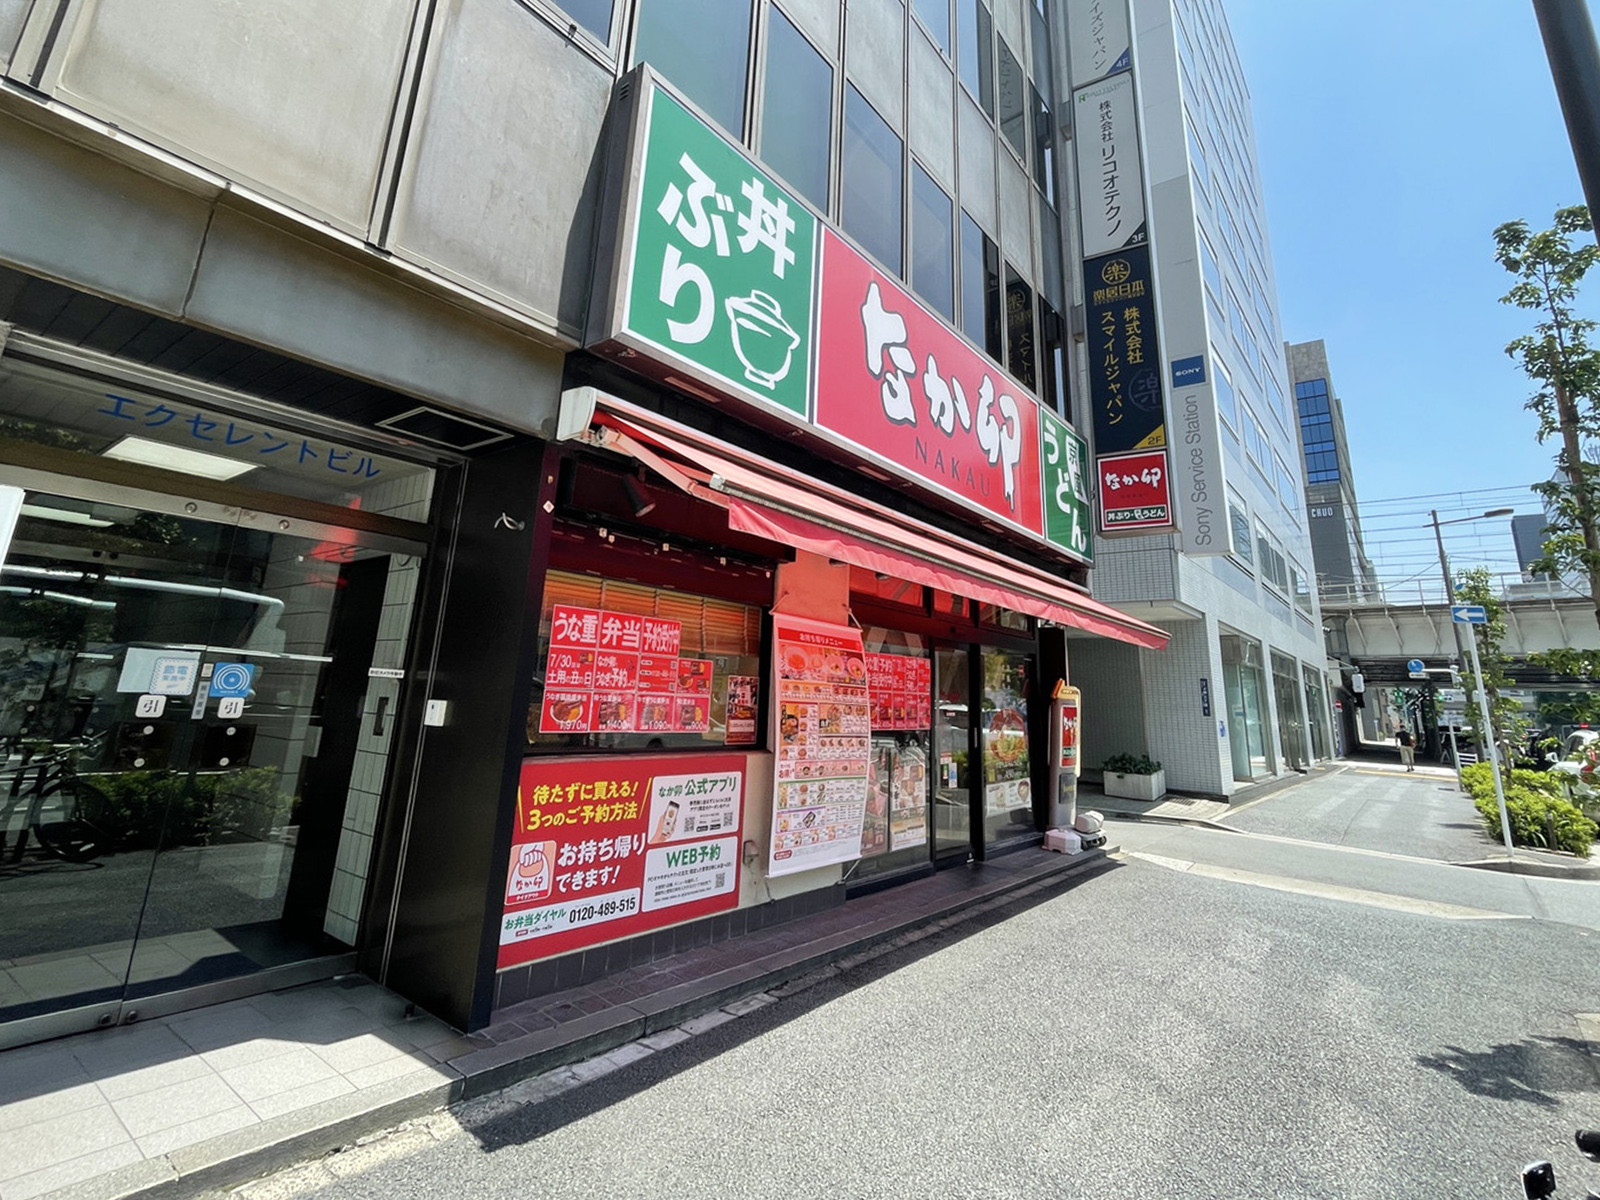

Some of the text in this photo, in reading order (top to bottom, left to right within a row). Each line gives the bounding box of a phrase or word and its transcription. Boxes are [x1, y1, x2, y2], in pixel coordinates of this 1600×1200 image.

[1116, 57, 1129, 67] 4F
[1132, 232, 1145, 243] 3F
[1124, 306, 1143, 364] 株式会社
[1101, 311, 1123, 425] スマイルジャパン
[1175, 367, 1201, 377] SONY
[860, 280, 1022, 512] なか卯
[97, 393, 380, 478] エクセレントビル
[1148, 435, 1161, 445] 2F
[914, 434, 991, 498] NAKAU
[1105, 467, 1162, 490] なか卯
[1184, 394, 1213, 546] Sony Service Station
[1043, 419, 1087, 553] うどん
[533, 780, 639, 806] 待たずに買える!
[527, 800, 638, 830] 3つのご予約方法
[557, 832, 646, 867] お持ち帰り
[666, 843, 721, 869] WEB予約
[556, 865, 620, 893] できます!
[504, 896, 636, 931] お弁当ダイヤル 0120-489-515
